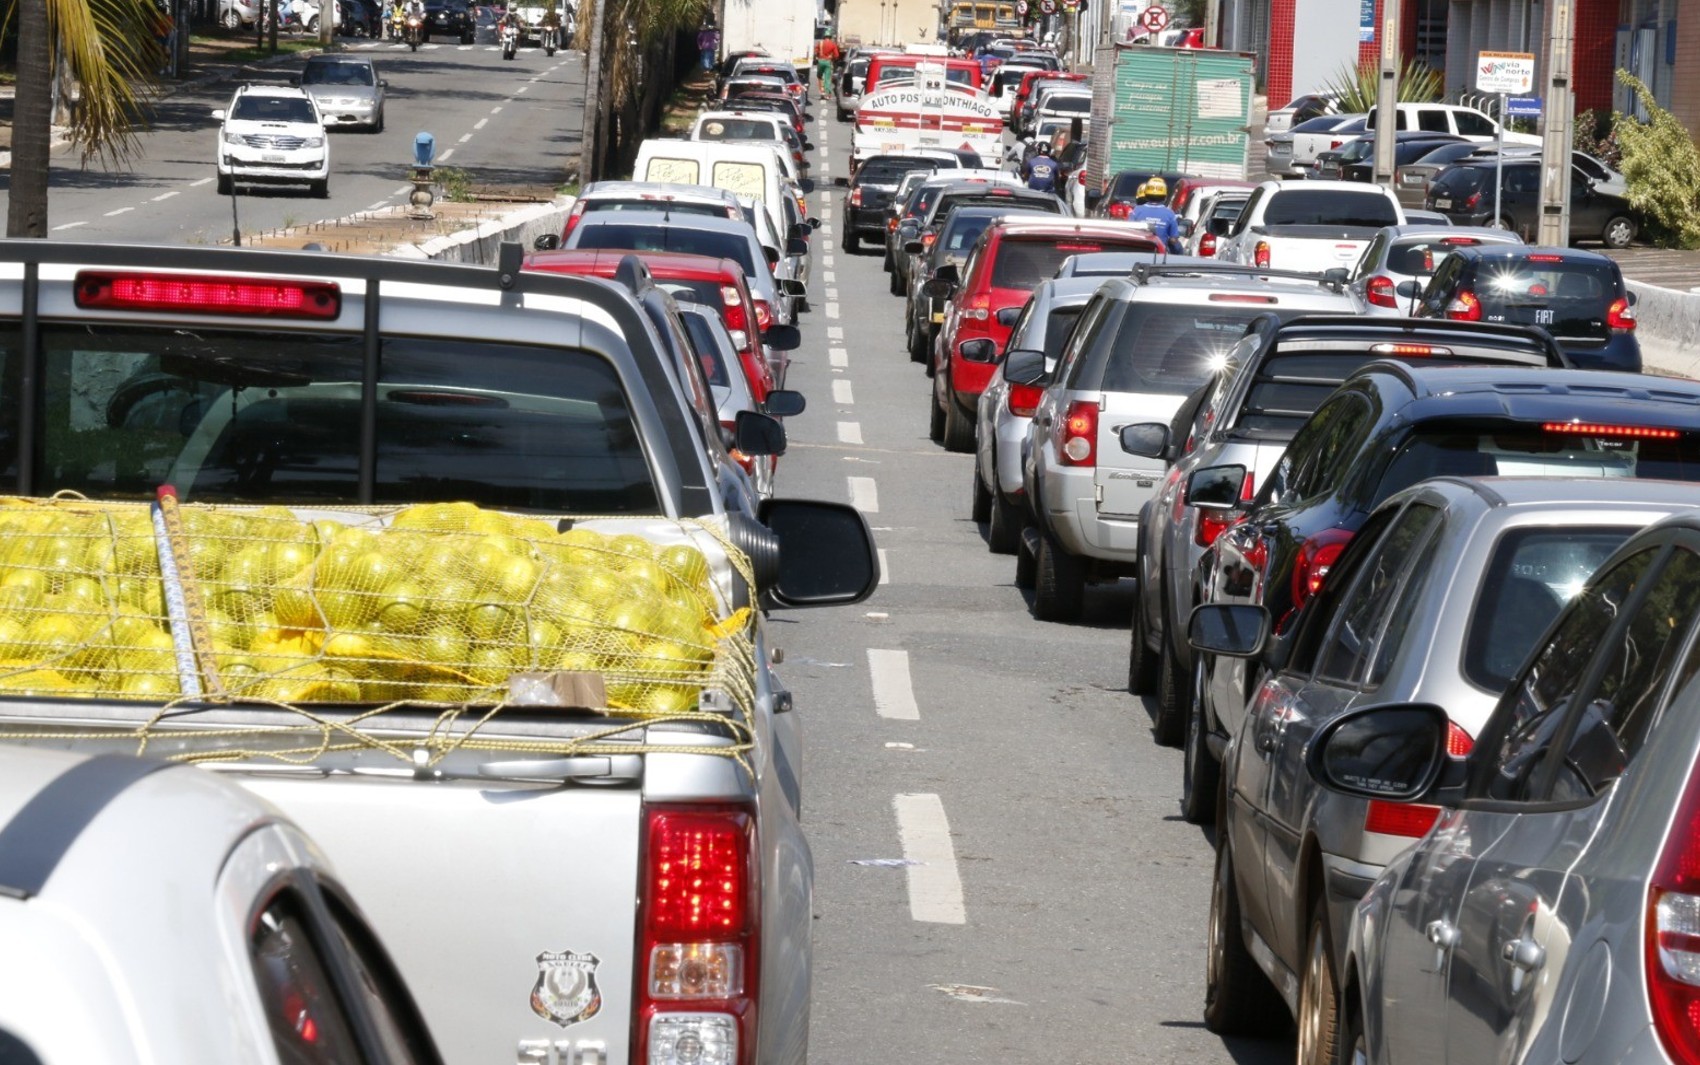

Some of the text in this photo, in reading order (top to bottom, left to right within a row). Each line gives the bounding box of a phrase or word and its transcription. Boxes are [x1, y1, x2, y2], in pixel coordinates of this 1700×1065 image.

[871, 93, 992, 117] AUTO POSO MONTHIAGO
[1535, 309, 1554, 324] FIAT
